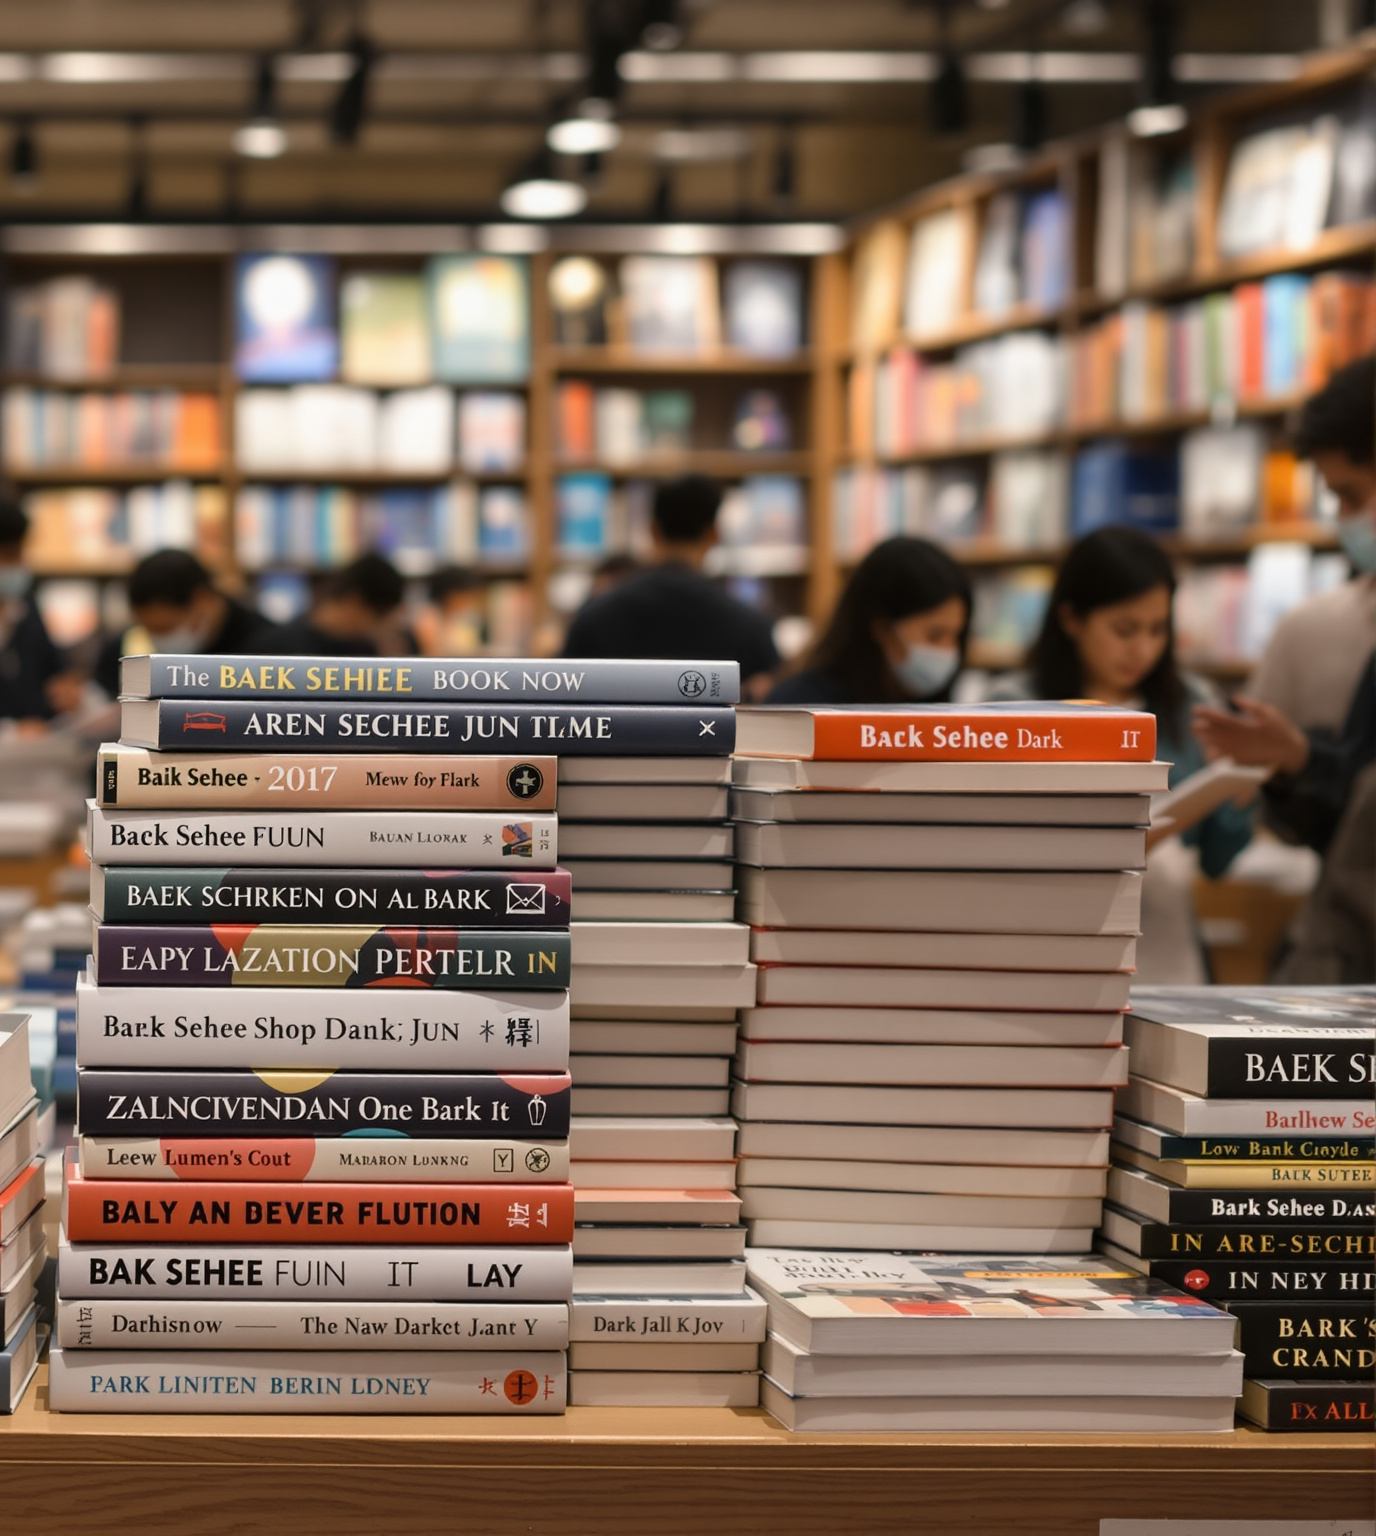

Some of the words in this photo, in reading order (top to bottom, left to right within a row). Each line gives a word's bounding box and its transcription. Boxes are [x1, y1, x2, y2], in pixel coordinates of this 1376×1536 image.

[167, 665, 209, 687] The
[220, 665, 296, 689] BAEK
[433, 670, 510, 690] BOOK
[522, 671, 585, 691] NOW
[244, 713, 326, 736] AREN
[338, 714, 450, 737] SECHEE
[461, 715, 520, 742] JUN
[860, 724, 924, 749] Back
[933, 725, 1009, 749] Sehee
[1017, 727, 1064, 750] Dark
[138, 767, 182, 786] Baik
[188, 767, 248, 787] Sehee
[267, 765, 338, 792] 2017
[110, 824, 169, 846] Back
[176, 824, 246, 847] Sehee
[253, 827, 324, 848] FUUN
[127, 885, 192, 907] BAEK
[202, 886, 324, 908] SCHRKEN
[335, 887, 377, 909] ON
[424, 888, 491, 910] BARK
[121, 946, 195, 971] EAPY
[204, 947, 361, 974] LAZATION
[376, 948, 515, 976] PERTELR
[174, 1016, 247, 1038] Sehee
[254, 1017, 316, 1045] Shop
[1245, 1053, 1339, 1083] BAEK
[106, 1095, 350, 1120] ZALNCIVENDAN
[358, 1096, 413, 1121] One
[421, 1096, 481, 1121] Bark
[107, 1148, 157, 1166] Leew
[164, 1149, 242, 1167] Lumen's
[247, 1150, 291, 1167] Cout
[102, 1200, 178, 1224] BALY
[189, 1201, 230, 1225] AN
[358, 1201, 480, 1226] FLUTION
[1211, 1198, 1261, 1216] Bark
[1267, 1198, 1325, 1217] Sehee
[1170, 1233, 1203, 1252] IN
[89, 1258, 157, 1285] BAK
[165, 1258, 263, 1286] SEHEE
[276, 1260, 345, 1287] FUIN
[387, 1261, 419, 1287] IT
[467, 1263, 523, 1288] LAY
[1228, 1272, 1259, 1290] IN
[1270, 1272, 1327, 1290] NEY
[300, 1316, 338, 1335] The
[345, 1317, 388, 1335] Naw
[594, 1316, 636, 1333] Dark
[1273, 1348, 1376, 1368] CRAND
[90, 1376, 151, 1393] PARK
[269, 1377, 342, 1394] BERIN
[1325, 1402, 1374, 1420] ALL
